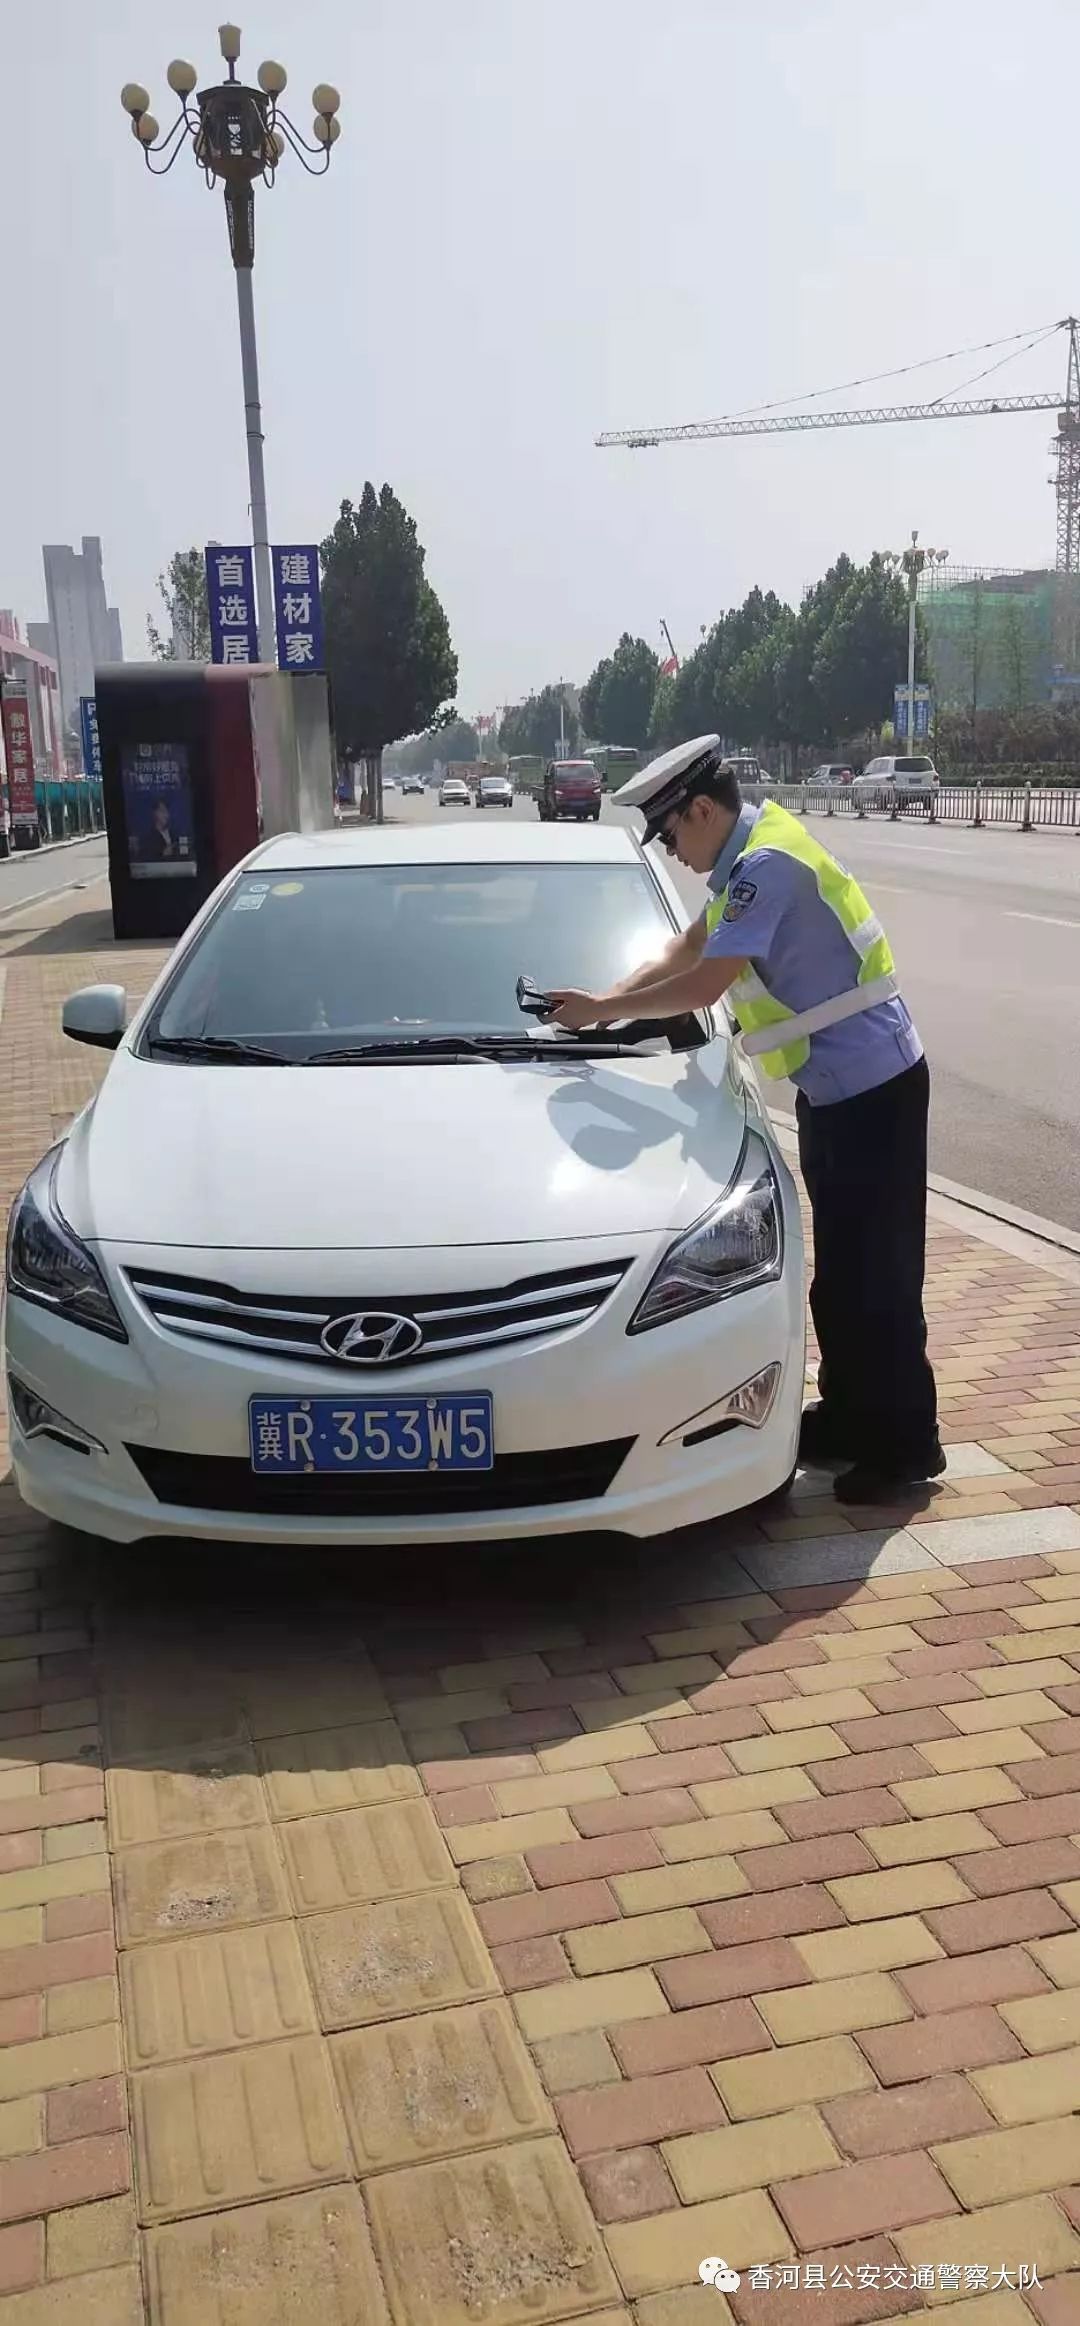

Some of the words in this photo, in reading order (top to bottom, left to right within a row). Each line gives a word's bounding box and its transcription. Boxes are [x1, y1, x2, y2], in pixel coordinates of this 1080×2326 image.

[215, 555, 250, 665] 首选居
[279, 553, 314, 664] 建材家
[256, 1409, 486, 1461] 冀R·353W5
